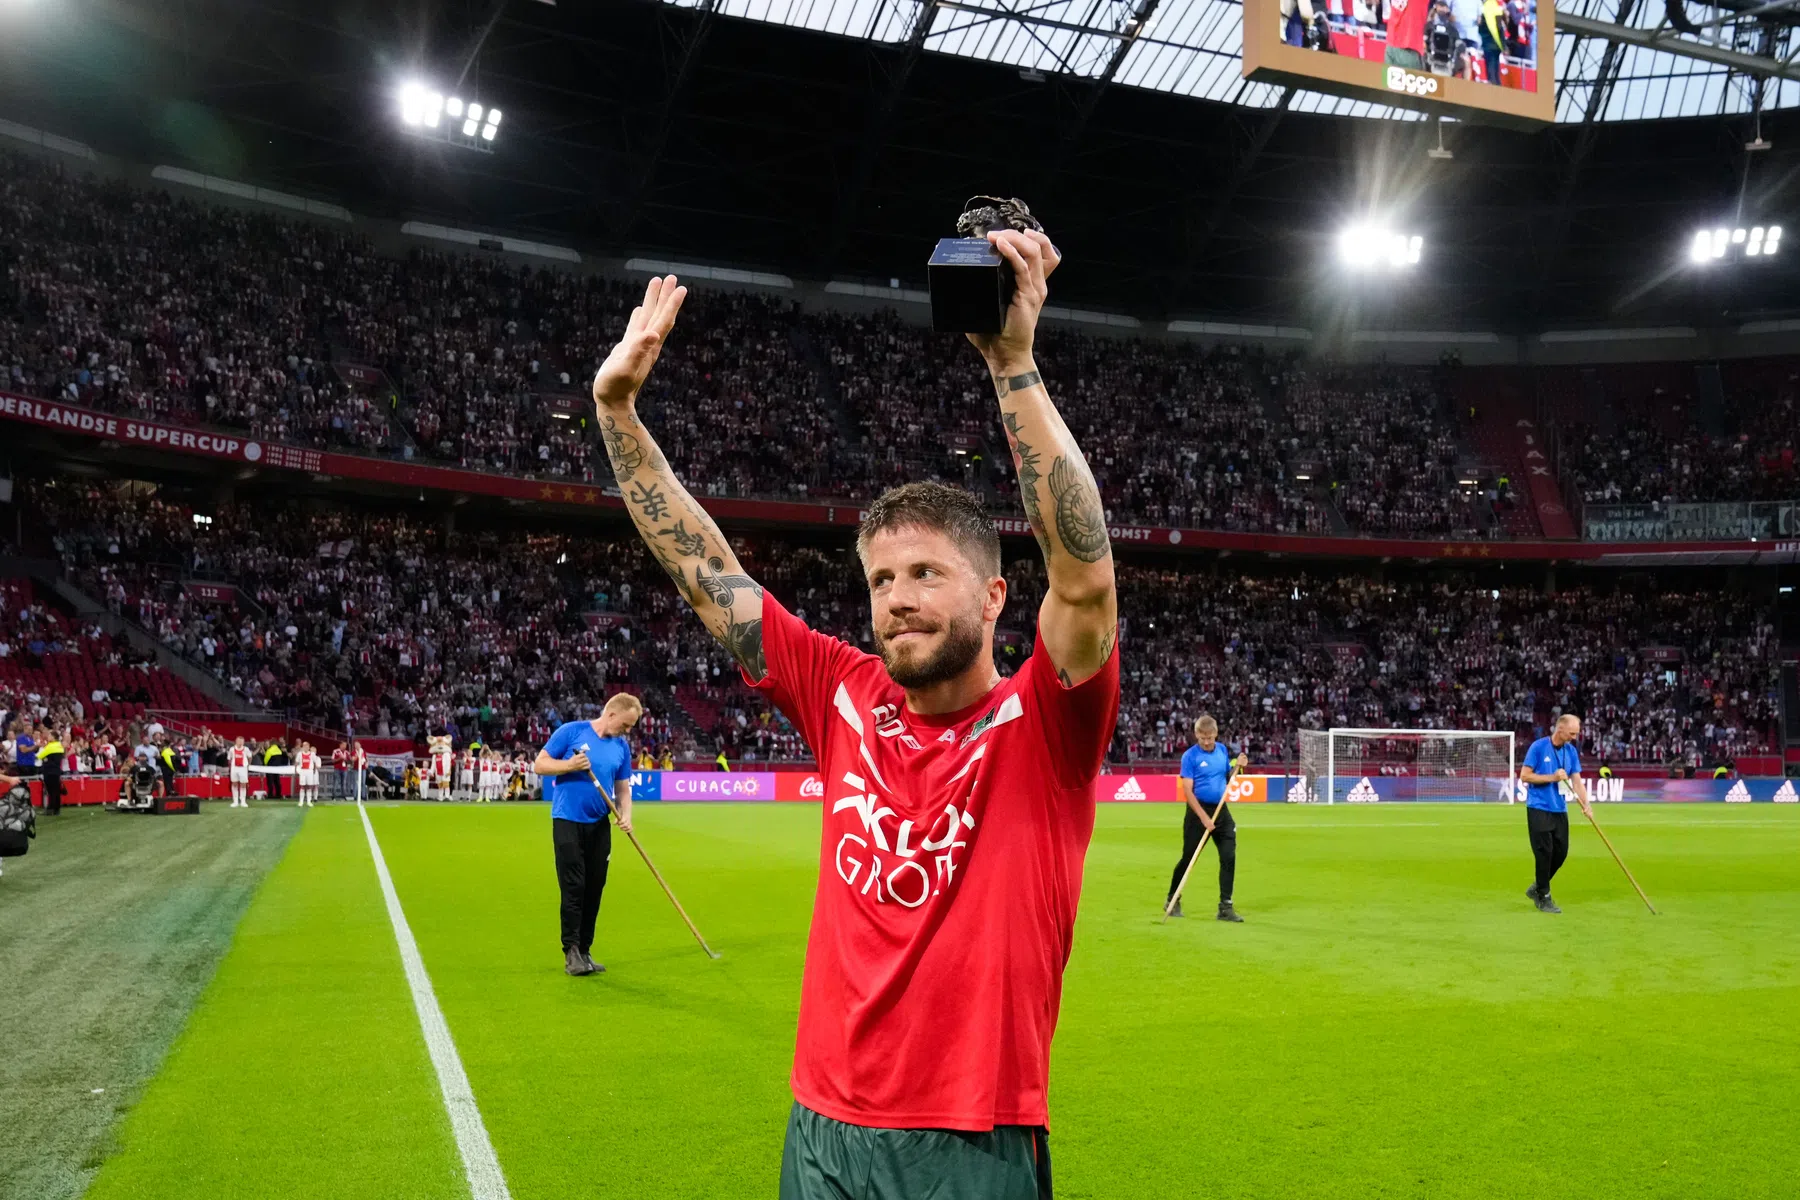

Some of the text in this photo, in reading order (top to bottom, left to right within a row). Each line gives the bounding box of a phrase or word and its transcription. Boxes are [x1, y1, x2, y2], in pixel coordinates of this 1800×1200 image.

[1387, 66, 1437, 94] Ziggo
[126, 423, 239, 454] SUPERCUP
[200, 587, 218, 598] 112
[675, 779, 758, 795] CURAÇAO
[833, 772, 978, 858] KLO
